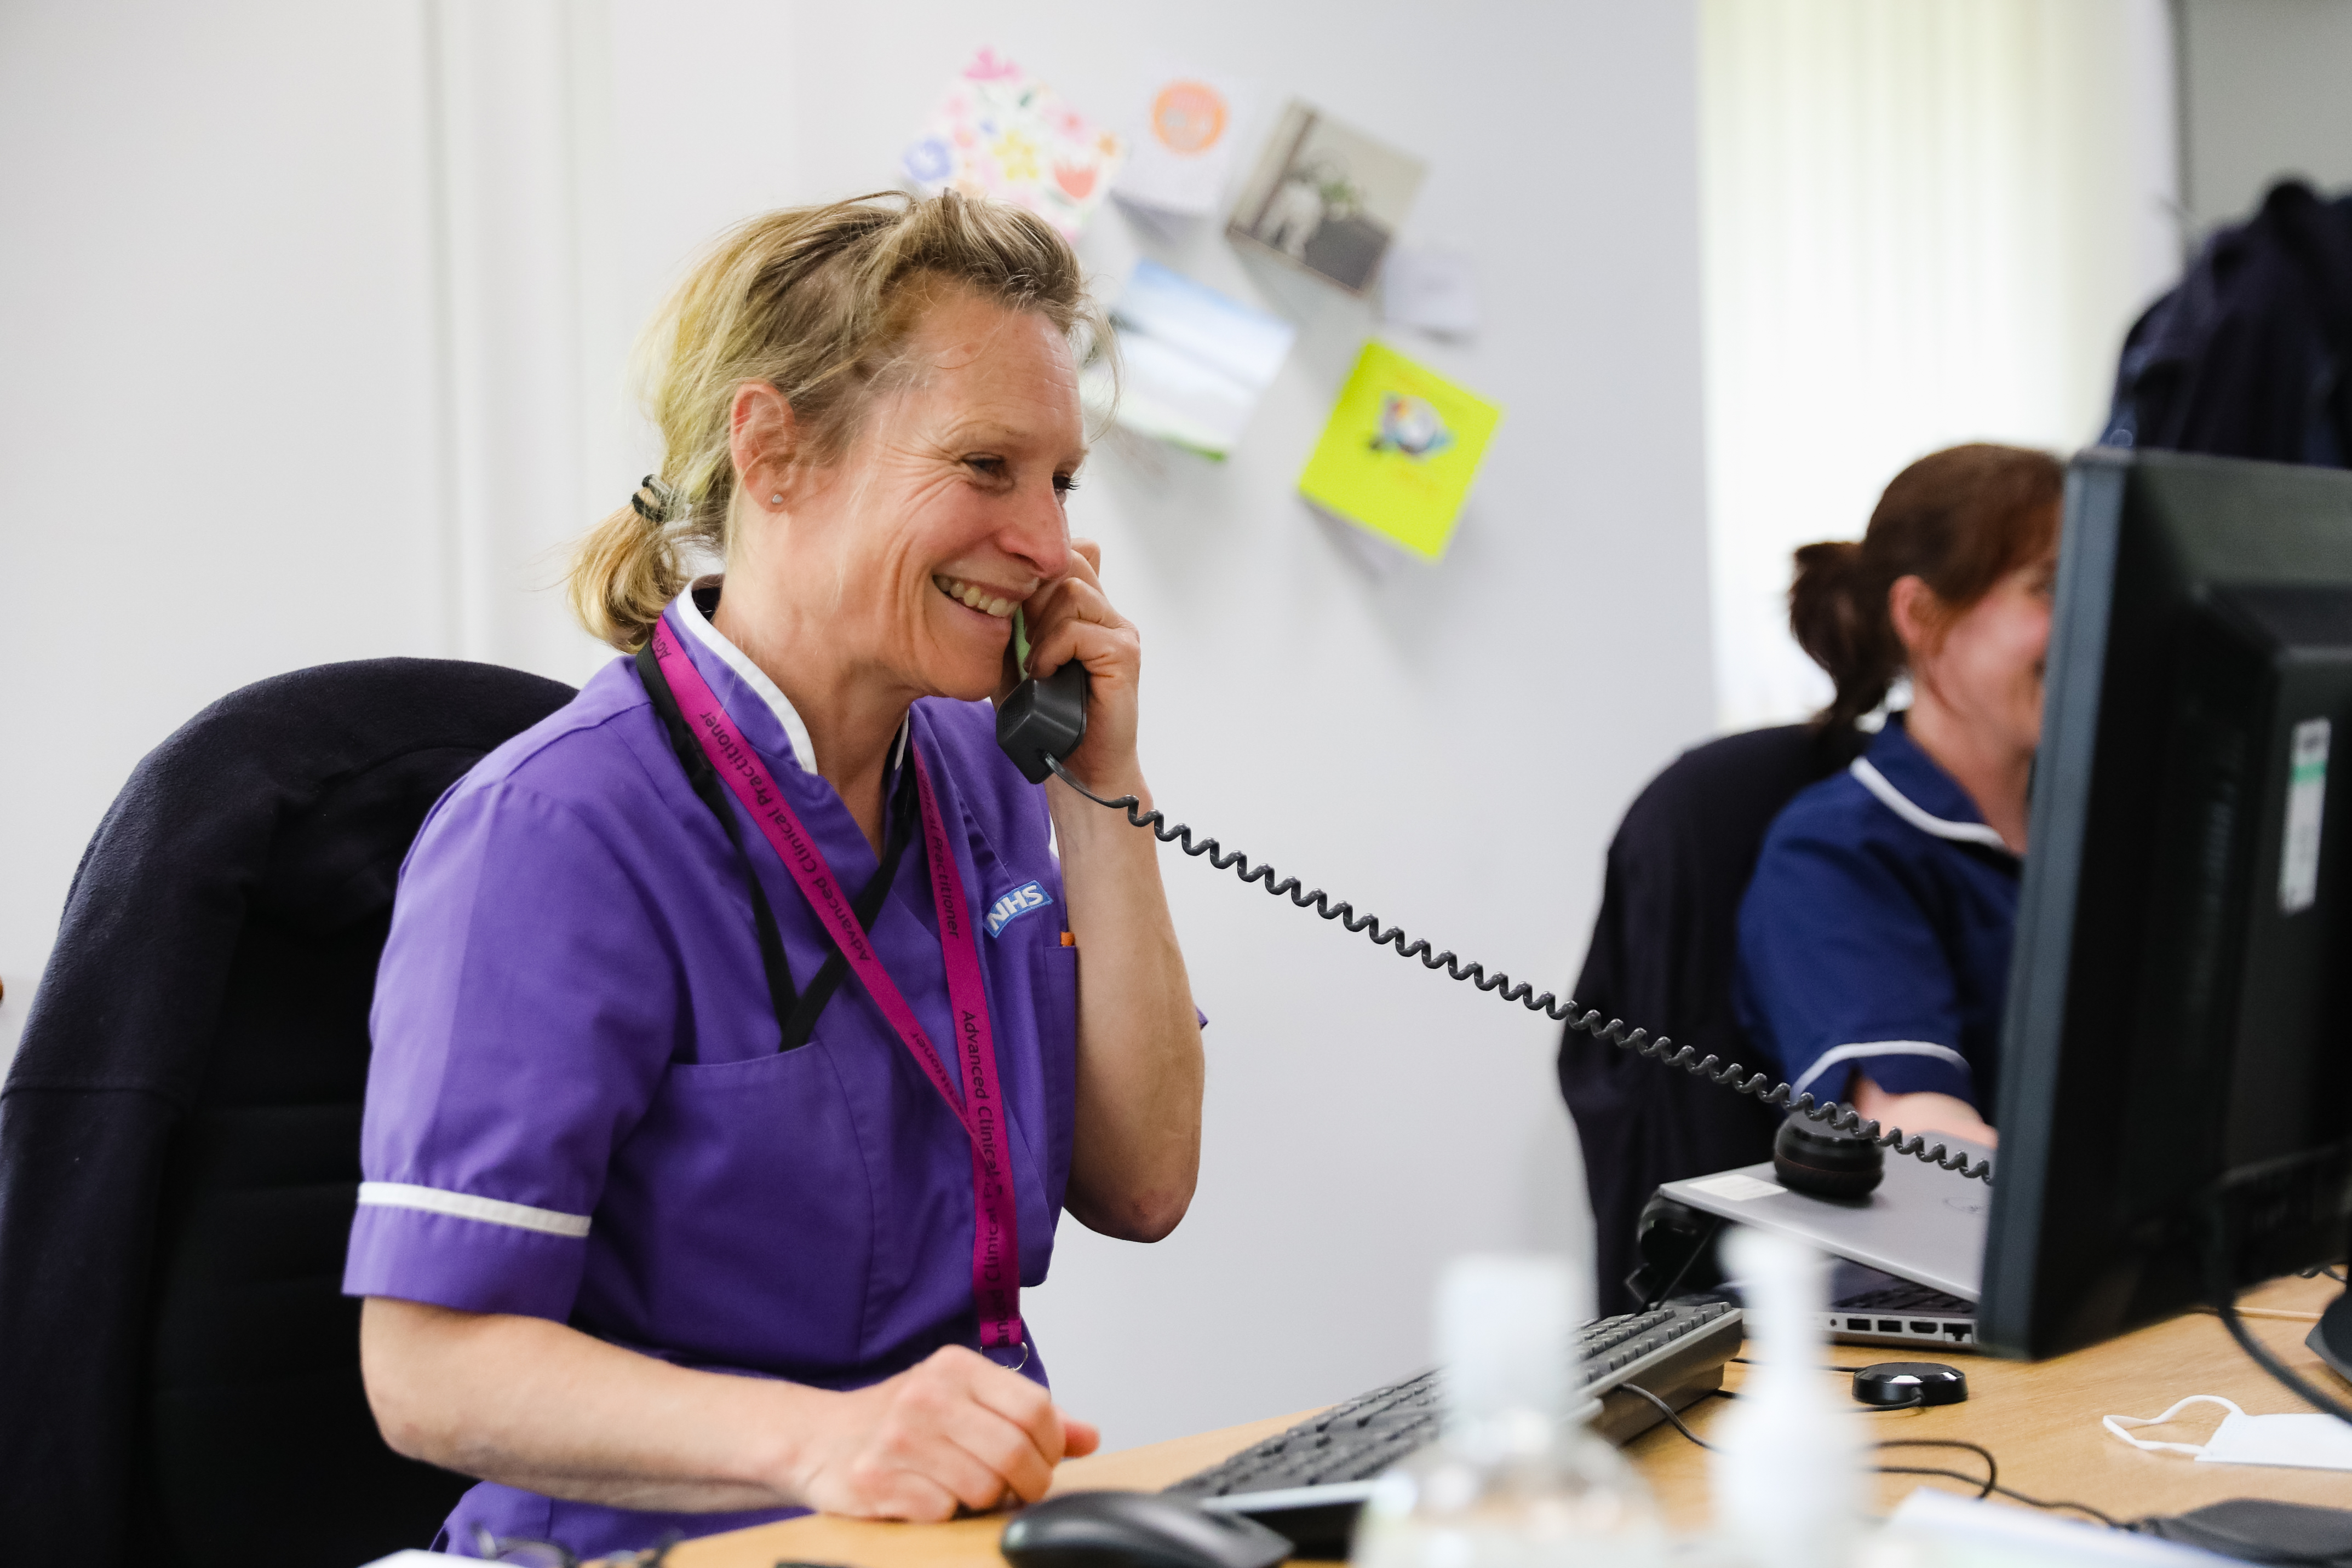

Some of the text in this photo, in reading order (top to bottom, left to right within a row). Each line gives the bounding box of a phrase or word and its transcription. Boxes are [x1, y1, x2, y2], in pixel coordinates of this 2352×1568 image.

[699, 711, 871, 962] Advanced Clinical Practitioner
[932, 836, 960, 939] Practitioner
[986, 884, 1043, 931] NHS
[962, 1010, 1002, 1175] Advanced Clinical
[984, 1208, 1001, 1282] Clinical
